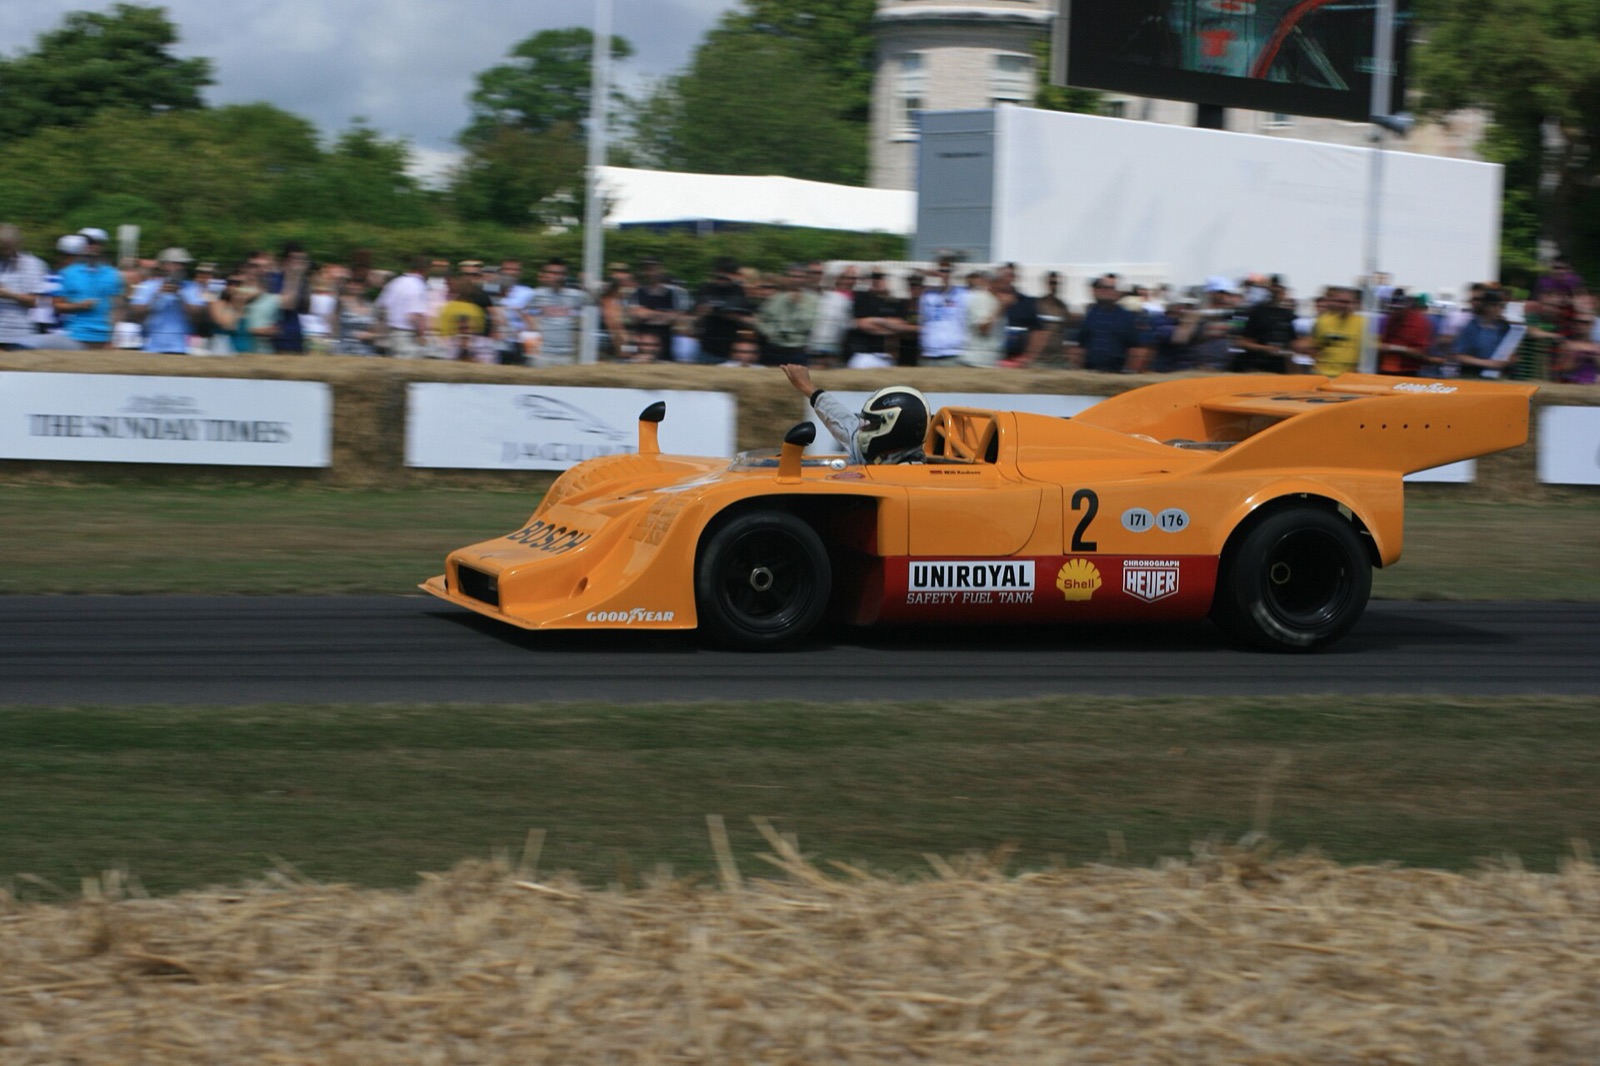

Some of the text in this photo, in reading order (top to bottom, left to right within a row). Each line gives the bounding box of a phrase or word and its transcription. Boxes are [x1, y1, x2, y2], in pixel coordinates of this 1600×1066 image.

[28, 414, 292, 443] THE SUNDAY TIMES
[1071, 488, 1099, 552] 2
[1130, 513, 1146, 526] 171
[1162, 514, 1183, 527] 176
[506, 520, 592, 555] BOSCH
[914, 565, 1030, 588] UNIROYAL
[1064, 578, 1094, 589] Shell
[1126, 570, 1176, 599] HEUER
[907, 592, 1033, 604] SAFETY FUEL TANK
[586, 607, 674, 624] GOODYEAR
